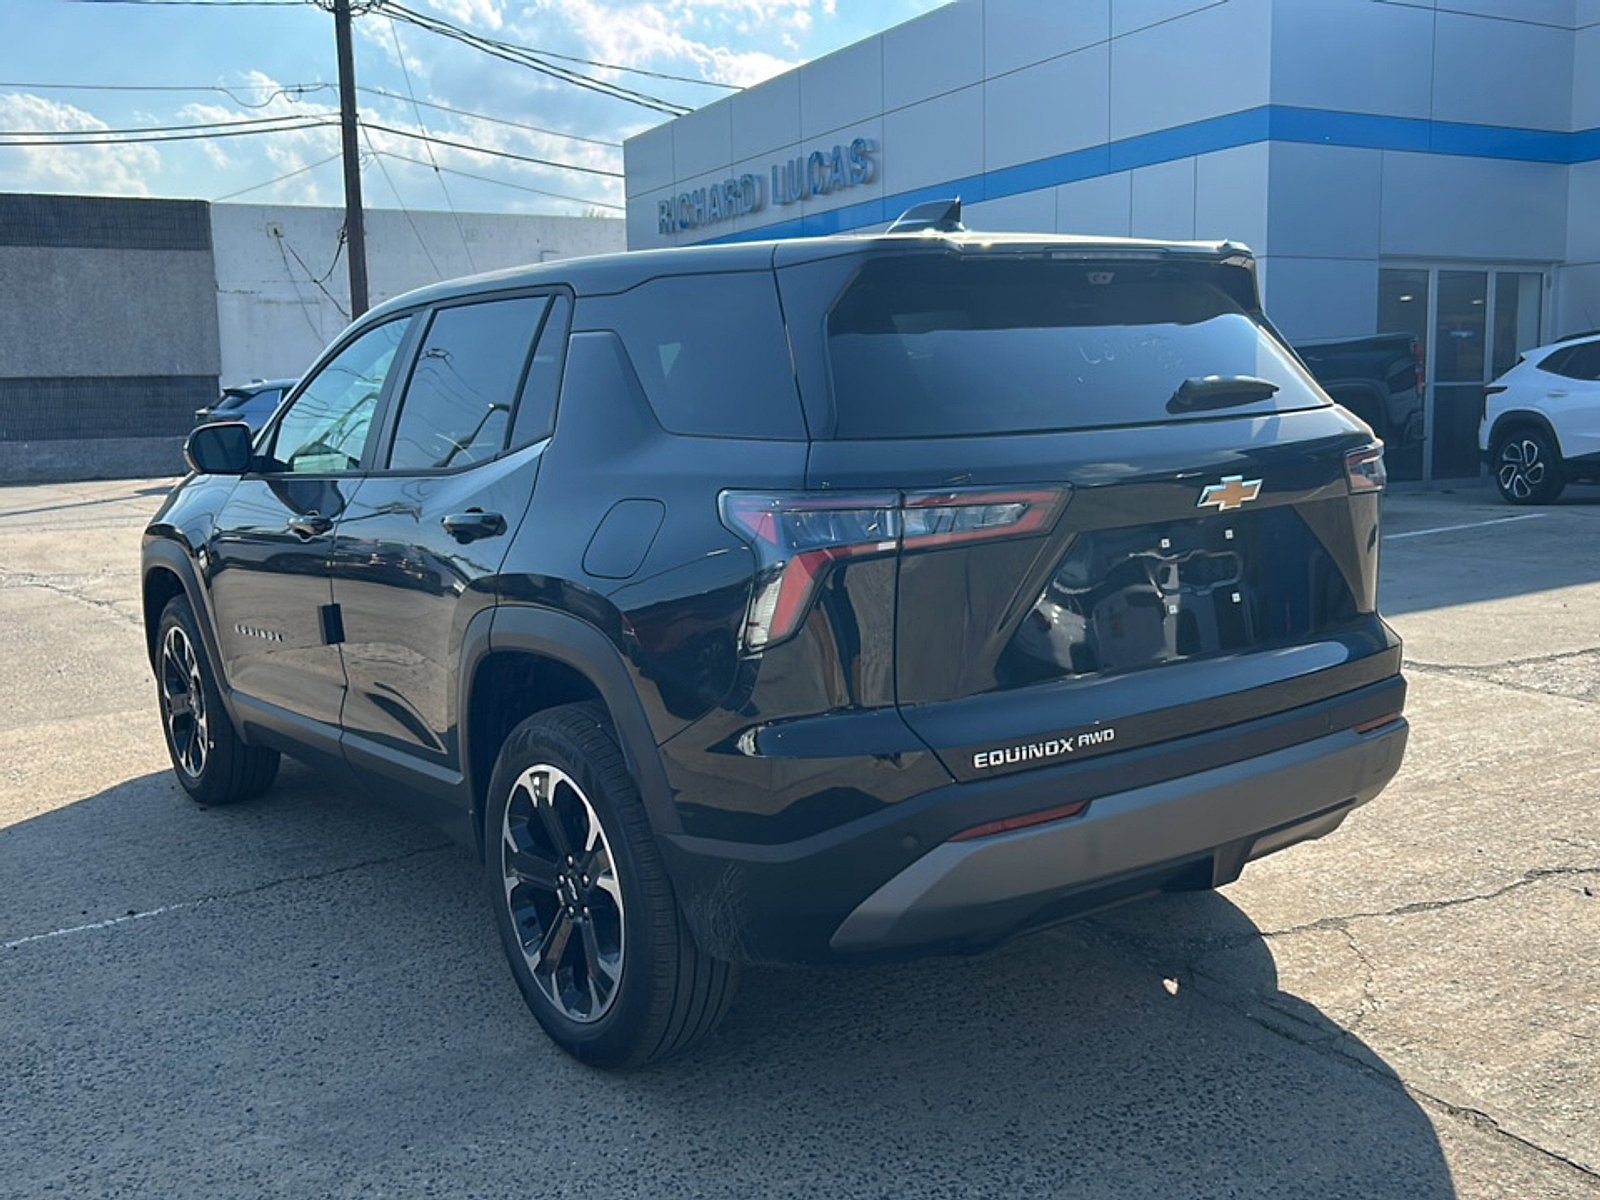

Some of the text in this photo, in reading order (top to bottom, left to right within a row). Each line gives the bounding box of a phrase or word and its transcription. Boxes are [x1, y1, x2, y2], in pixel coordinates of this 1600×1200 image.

[658, 138, 877, 234] RICHARD LUCAS
[973, 728, 1115, 769] EQUINOX AWD
